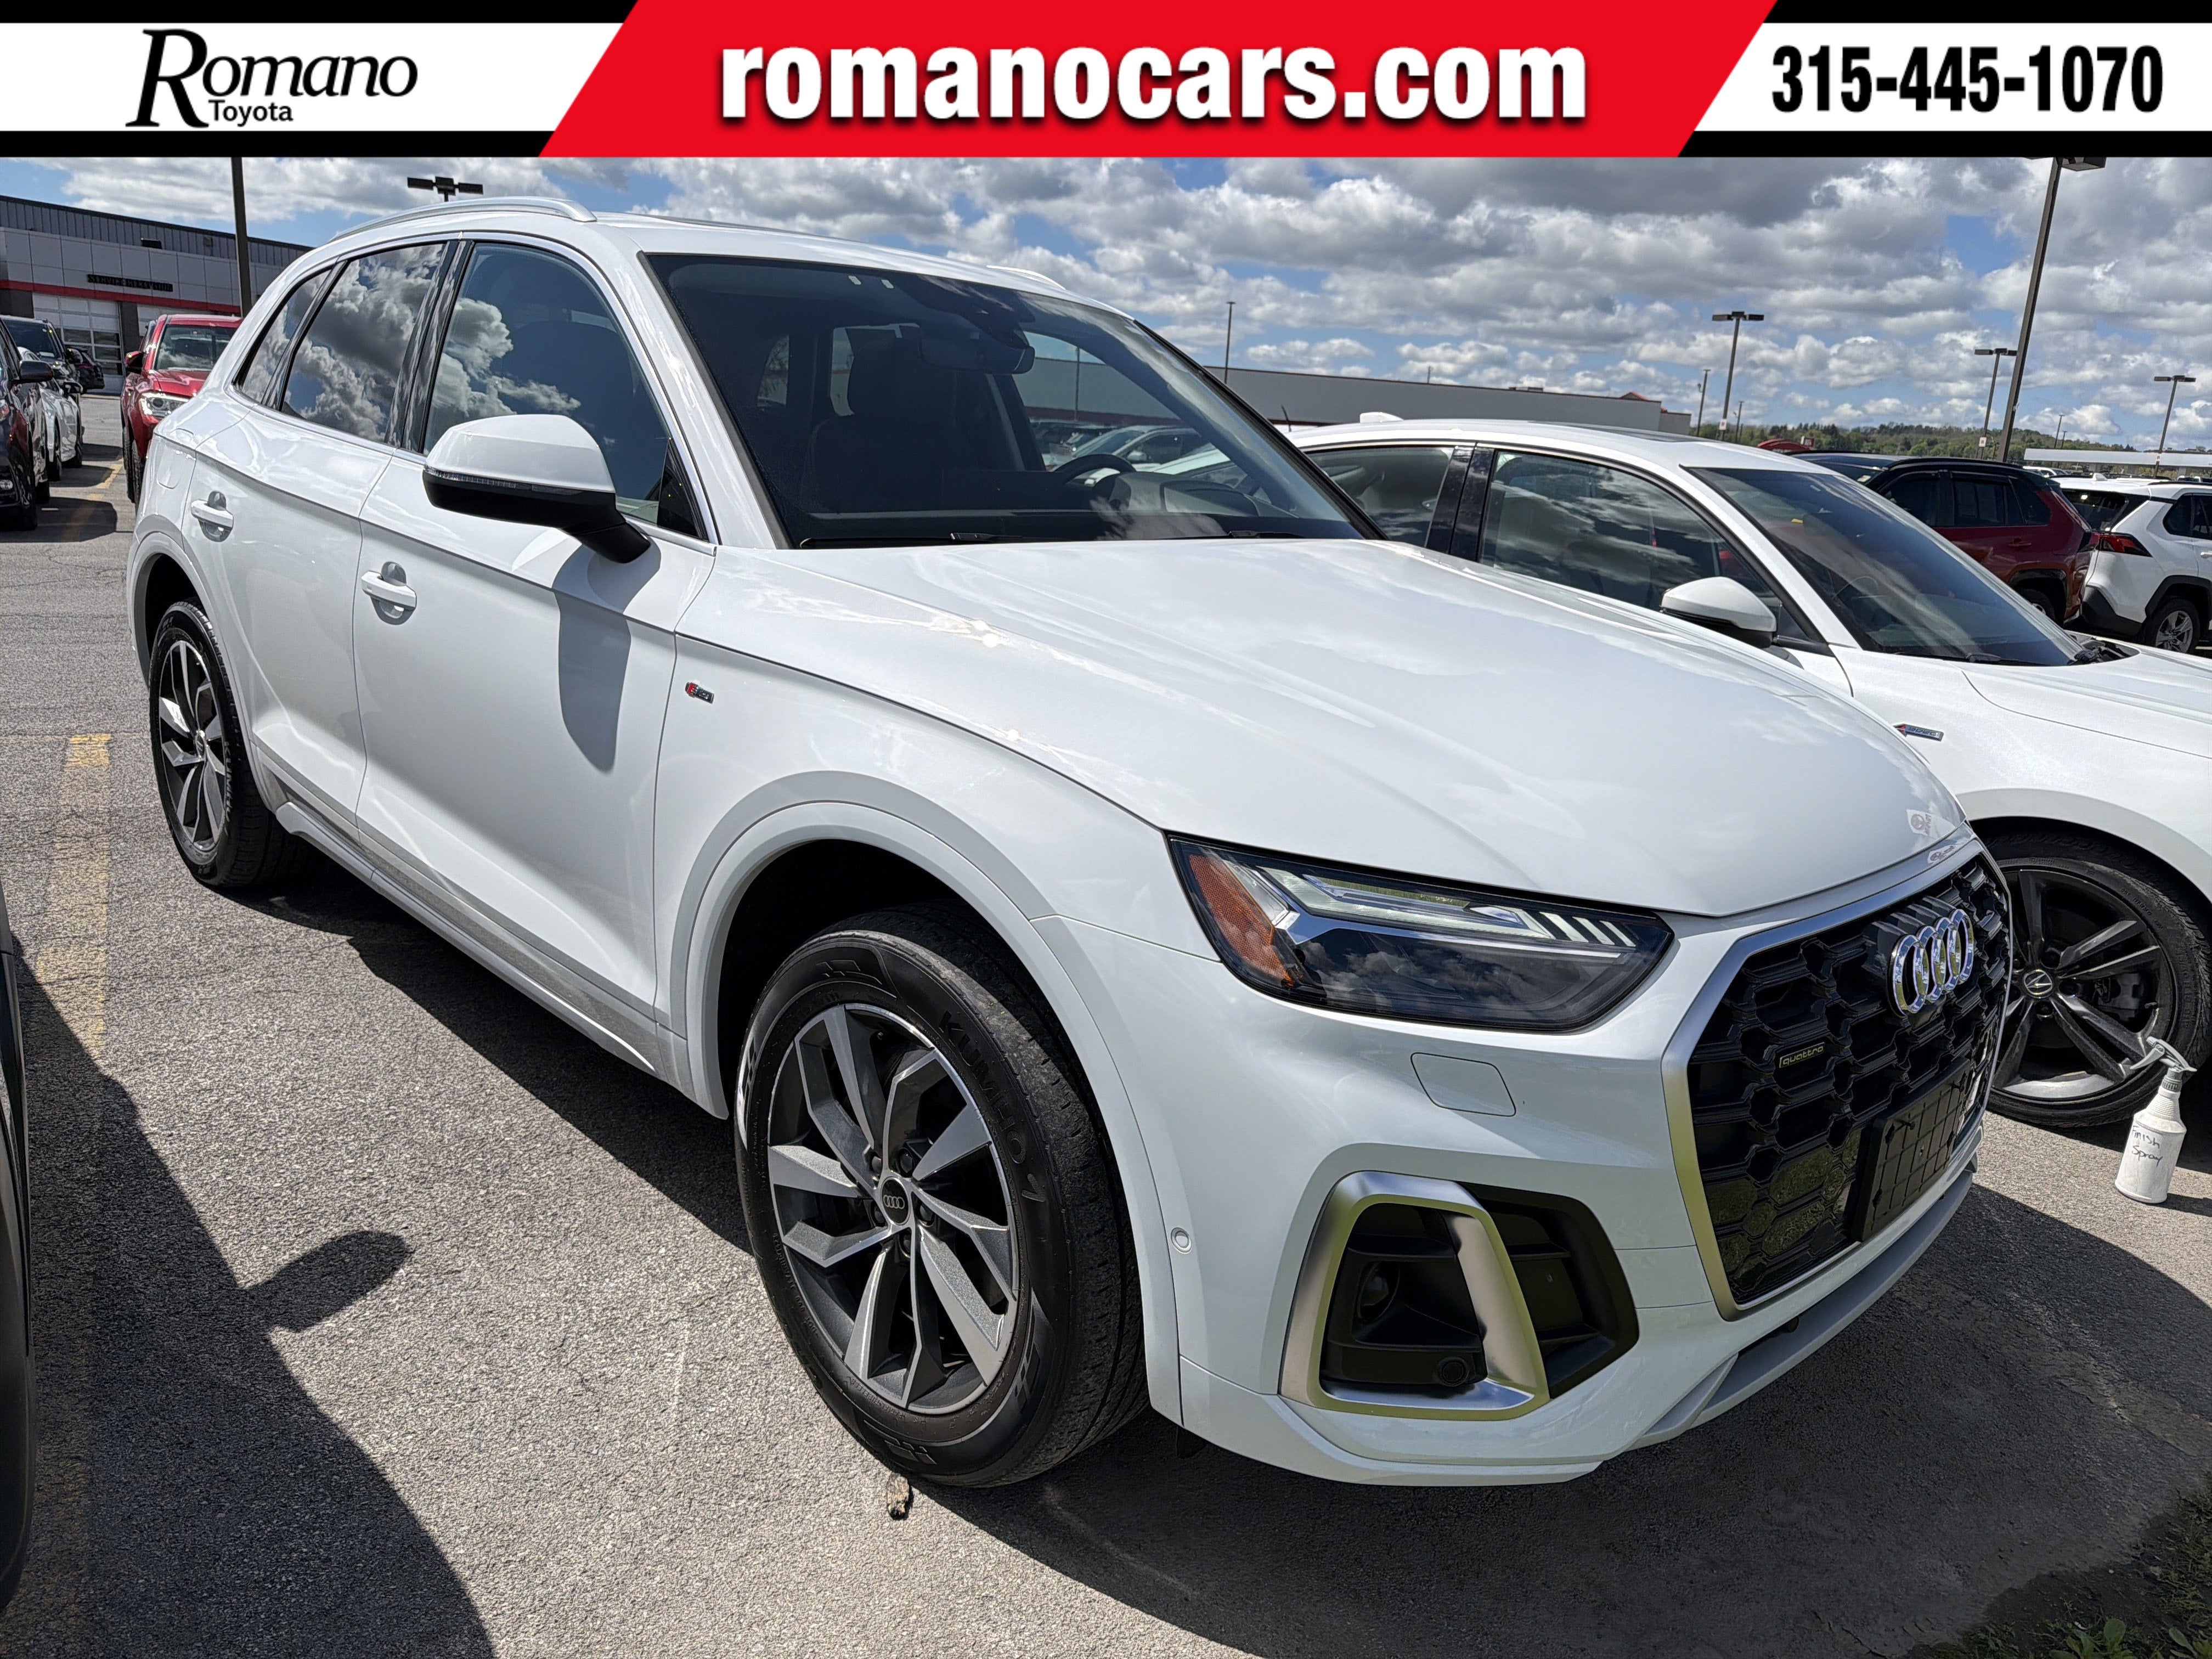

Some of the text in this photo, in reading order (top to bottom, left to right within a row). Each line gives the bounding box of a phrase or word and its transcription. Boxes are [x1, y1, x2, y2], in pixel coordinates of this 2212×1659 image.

[1782, 1045, 1824, 1066] quattro
[939, 1011, 1026, 1164] KUMHO
[2131, 1145, 2164, 1167] Spray
